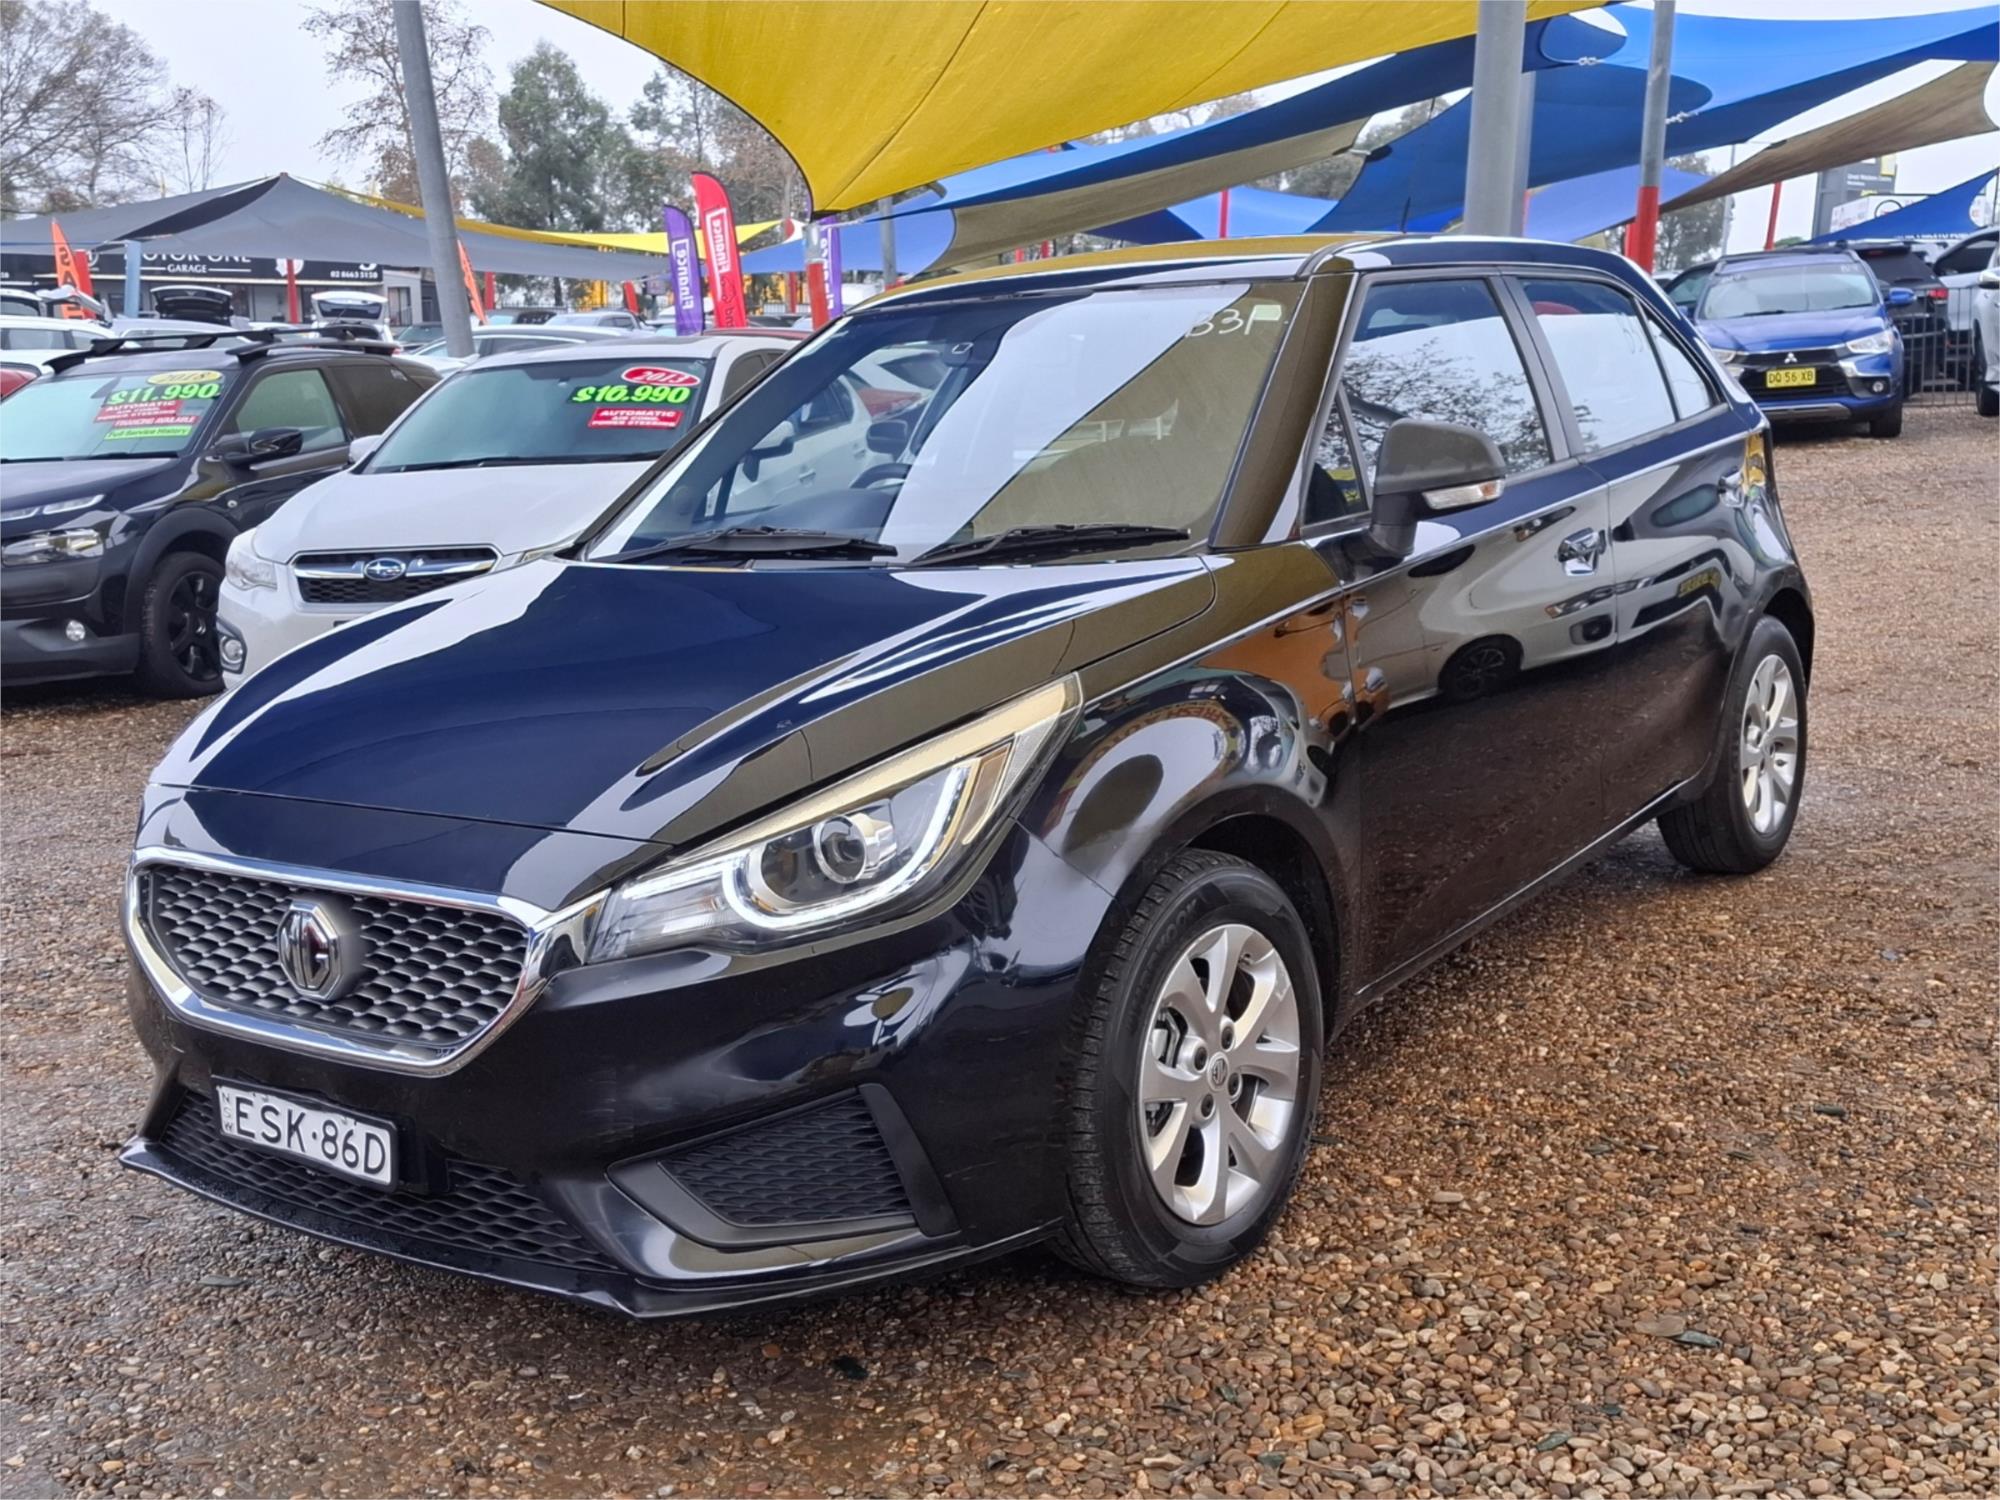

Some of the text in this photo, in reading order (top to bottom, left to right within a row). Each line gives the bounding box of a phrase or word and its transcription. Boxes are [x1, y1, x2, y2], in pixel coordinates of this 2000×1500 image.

[167, 264, 208, 274] GARAGE
[1784, 371, 1798, 383] 56
[1801, 370, 1814, 382] XB
[105, 400, 176, 412] AUTOMATIC
[600, 410, 677, 418] AUTOMATIC
